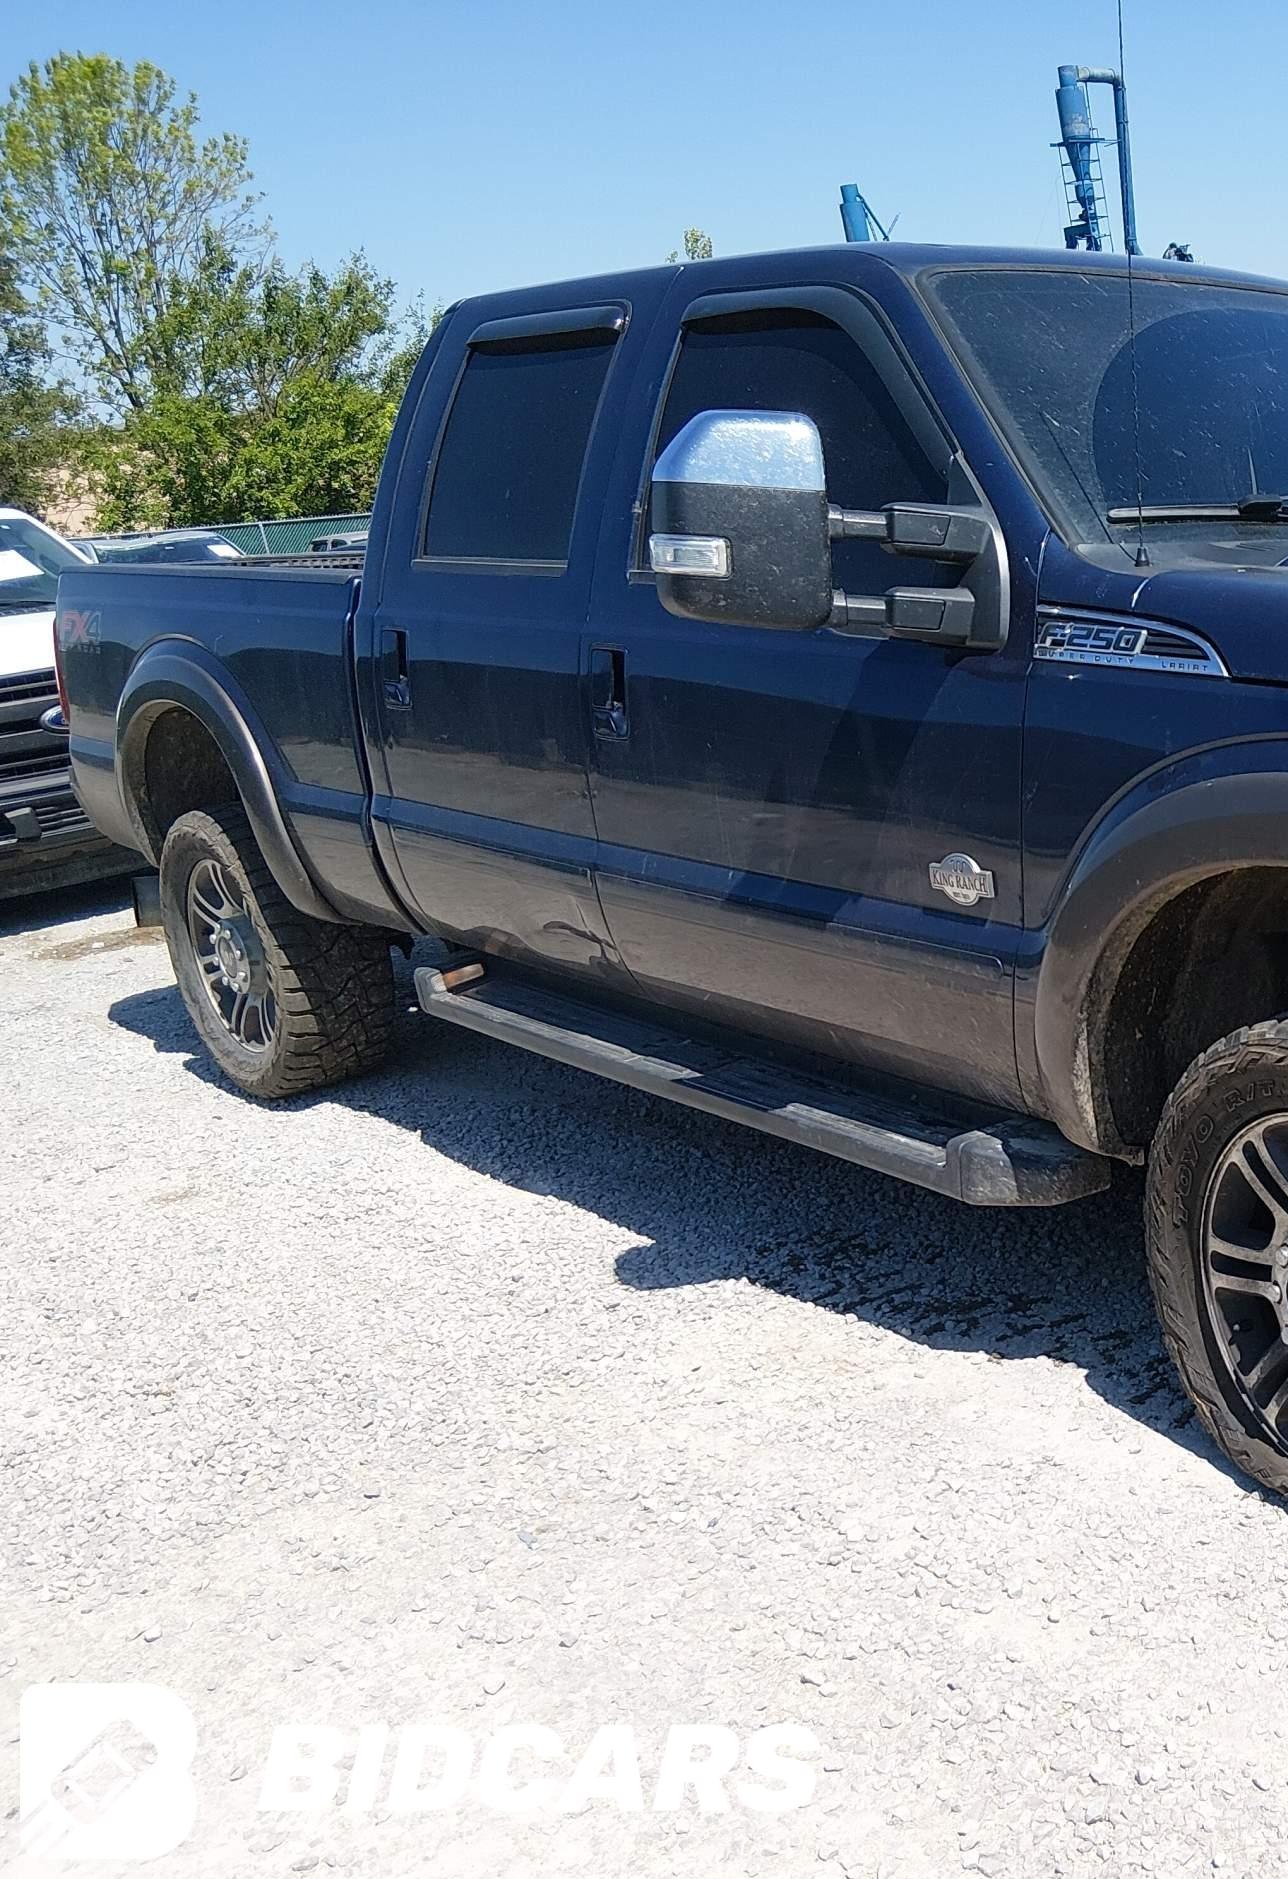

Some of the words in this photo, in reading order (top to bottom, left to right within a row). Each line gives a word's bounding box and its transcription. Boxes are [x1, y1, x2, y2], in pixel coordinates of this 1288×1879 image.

[61, 610, 102, 646] FX4
[1093, 655, 1135, 665] DUTY
[1160, 660, 1209, 672] LARIAT
[932, 868, 955, 888] KING
[956, 874, 988, 894] RANCH
